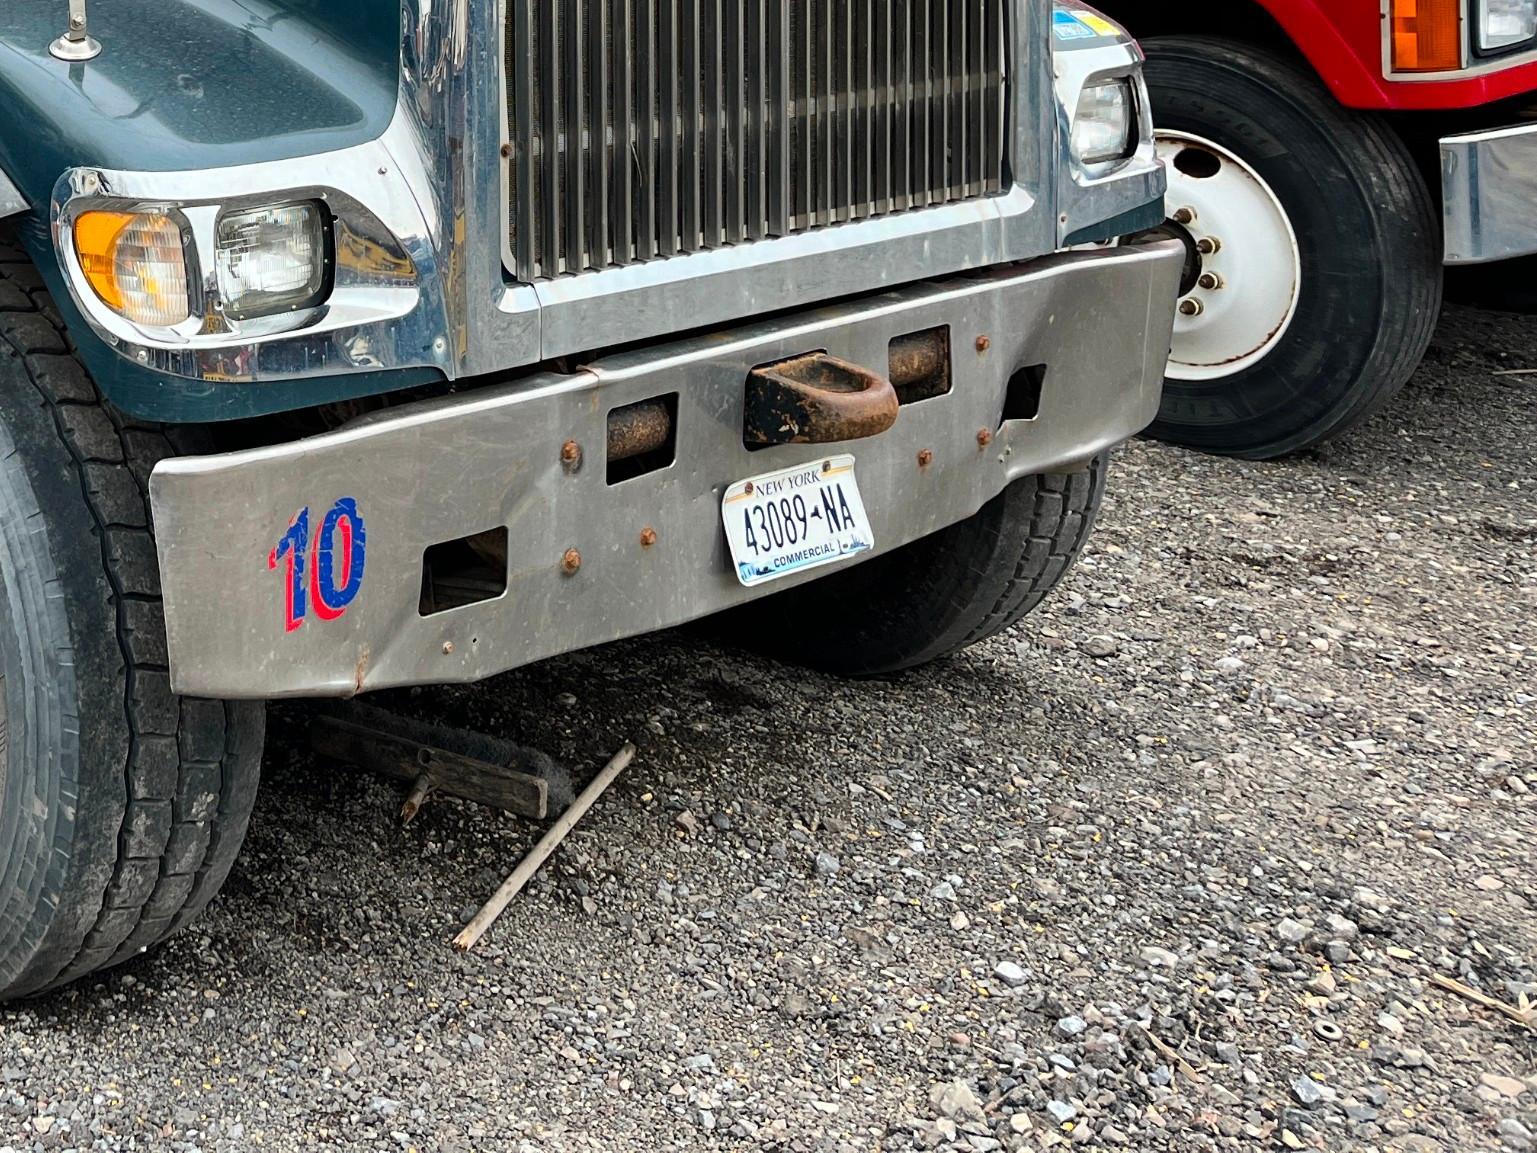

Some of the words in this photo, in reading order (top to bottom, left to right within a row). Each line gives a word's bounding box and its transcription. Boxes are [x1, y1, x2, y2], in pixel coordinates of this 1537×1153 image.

[756, 478, 786, 498] NEW
[787, 469, 821, 490] YORK
[267, 496, 366, 632] 10
[773, 542, 835, 568] COMMERCIAL
